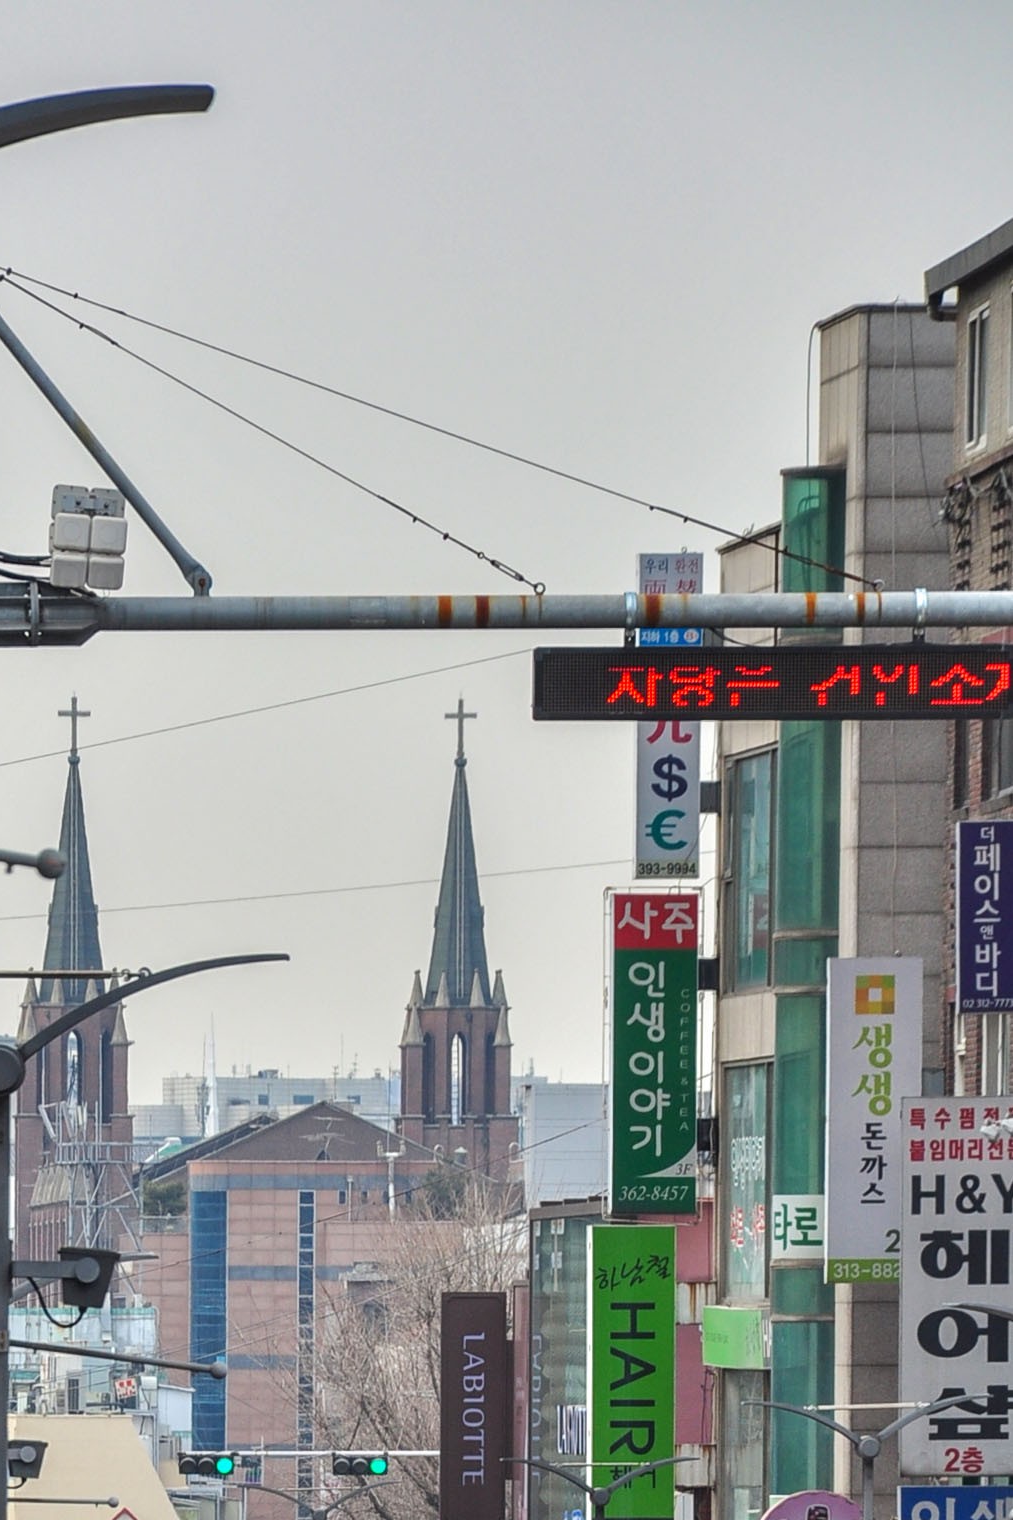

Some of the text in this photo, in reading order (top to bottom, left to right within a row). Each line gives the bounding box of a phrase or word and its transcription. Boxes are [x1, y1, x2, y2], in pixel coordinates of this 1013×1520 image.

[651, 754, 688, 802] $
[645, 809, 688, 851] €
[618, 901, 695, 944] 사주
[627, 961, 671, 1157] 인생이야기
[852, 1023, 893, 1204] 생생 돈까스
[619, 1186, 689, 1202] 362-8457
[774, 1203, 824, 1251] 타로
[610, 1302, 656, 1455] HAIR
[462, 1332, 486, 1487] LABIOTTE
[944, 1448, 985, 1473] 2층
